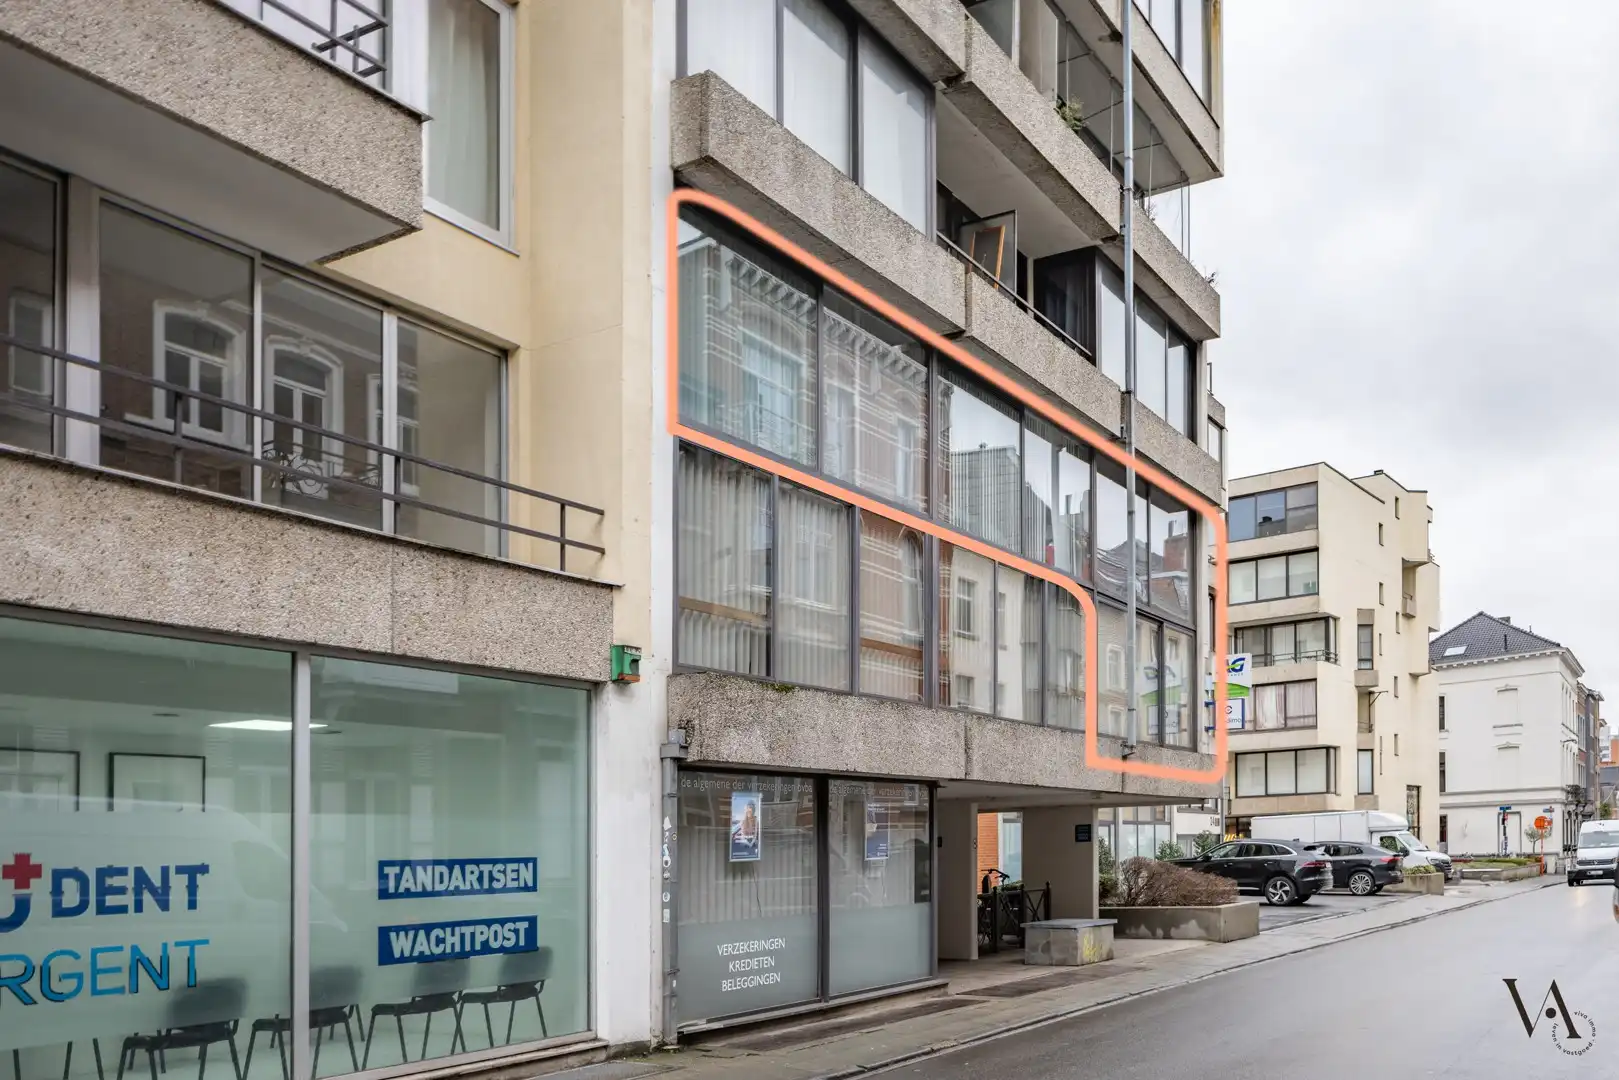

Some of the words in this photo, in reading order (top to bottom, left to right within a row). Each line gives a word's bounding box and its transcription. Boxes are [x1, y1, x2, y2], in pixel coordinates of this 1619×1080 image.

[681, 777, 691, 788] de
[693, 777, 730, 791] algemene
[732, 779, 746, 790] der
[51, 863, 210, 918] DENT
[383, 862, 533, 894] TANDARTSEN
[389, 921, 529, 959] WACHTPOST
[716, 937, 786, 956] VERZEKERINGEN
[0, 938, 210, 1006] RGENT
[728, 955, 775, 973] KREDIETEN
[721, 971, 781, 992] BELEGGINGEN
